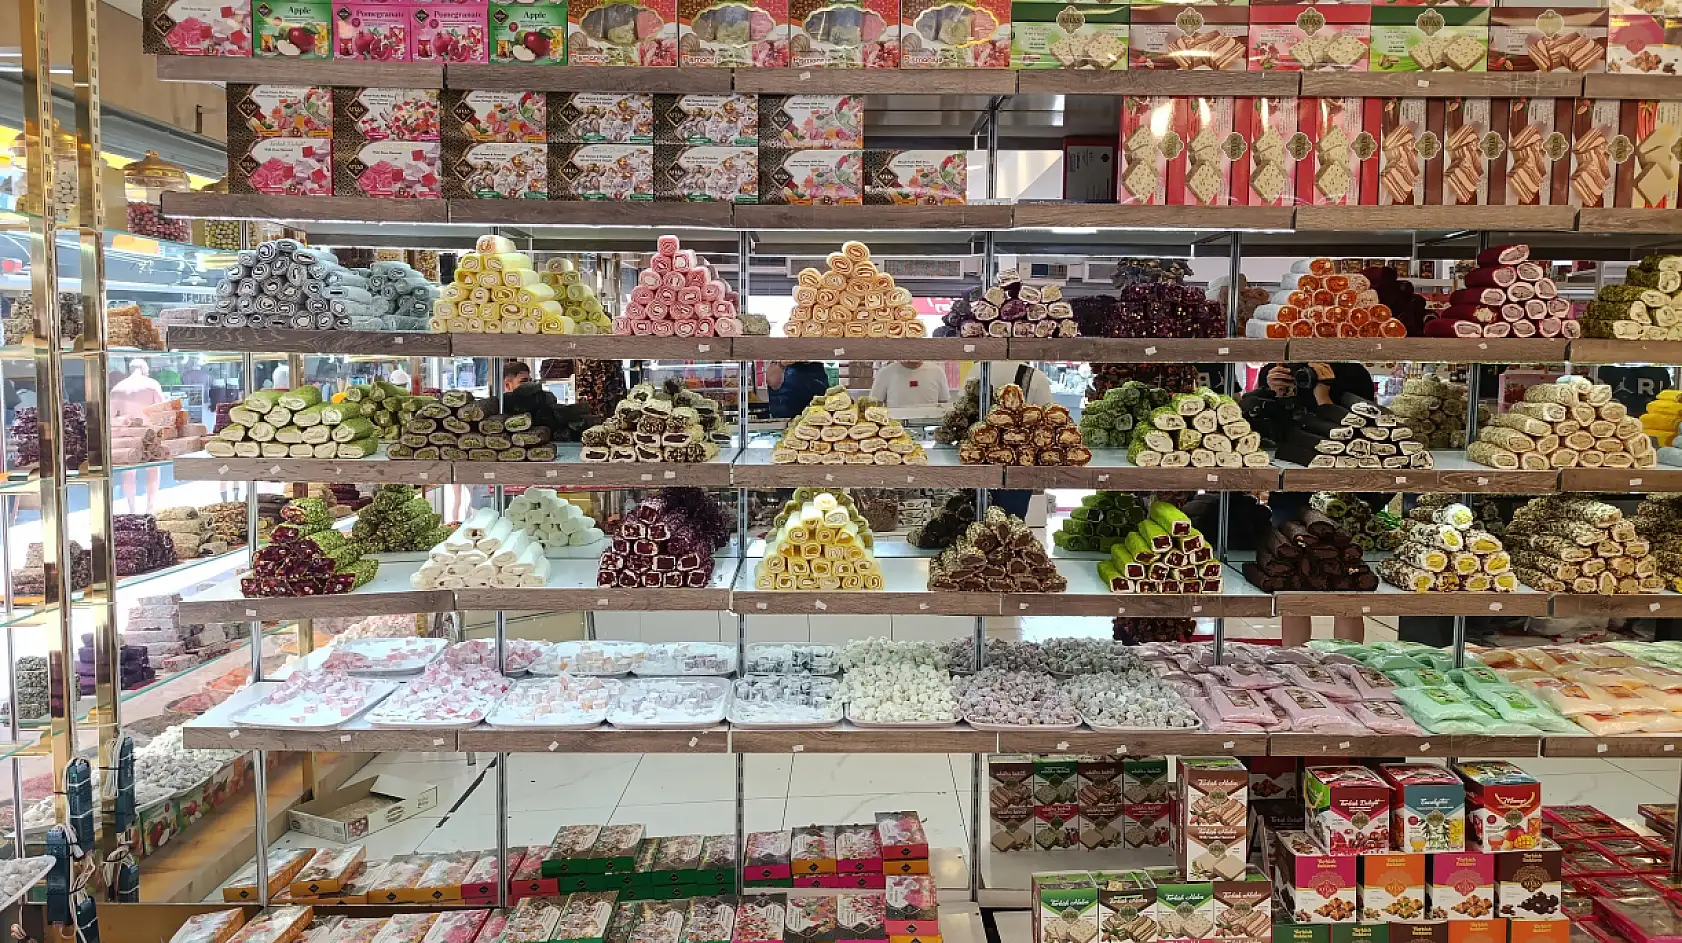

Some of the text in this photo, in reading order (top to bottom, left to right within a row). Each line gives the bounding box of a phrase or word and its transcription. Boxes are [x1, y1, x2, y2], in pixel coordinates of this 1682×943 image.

[288, 6, 312, 15] Apple
[356, 9, 404, 18] Pomegranate
[434, 10, 483, 18] Pomegranate
[524, 11, 547, 20] Apple
